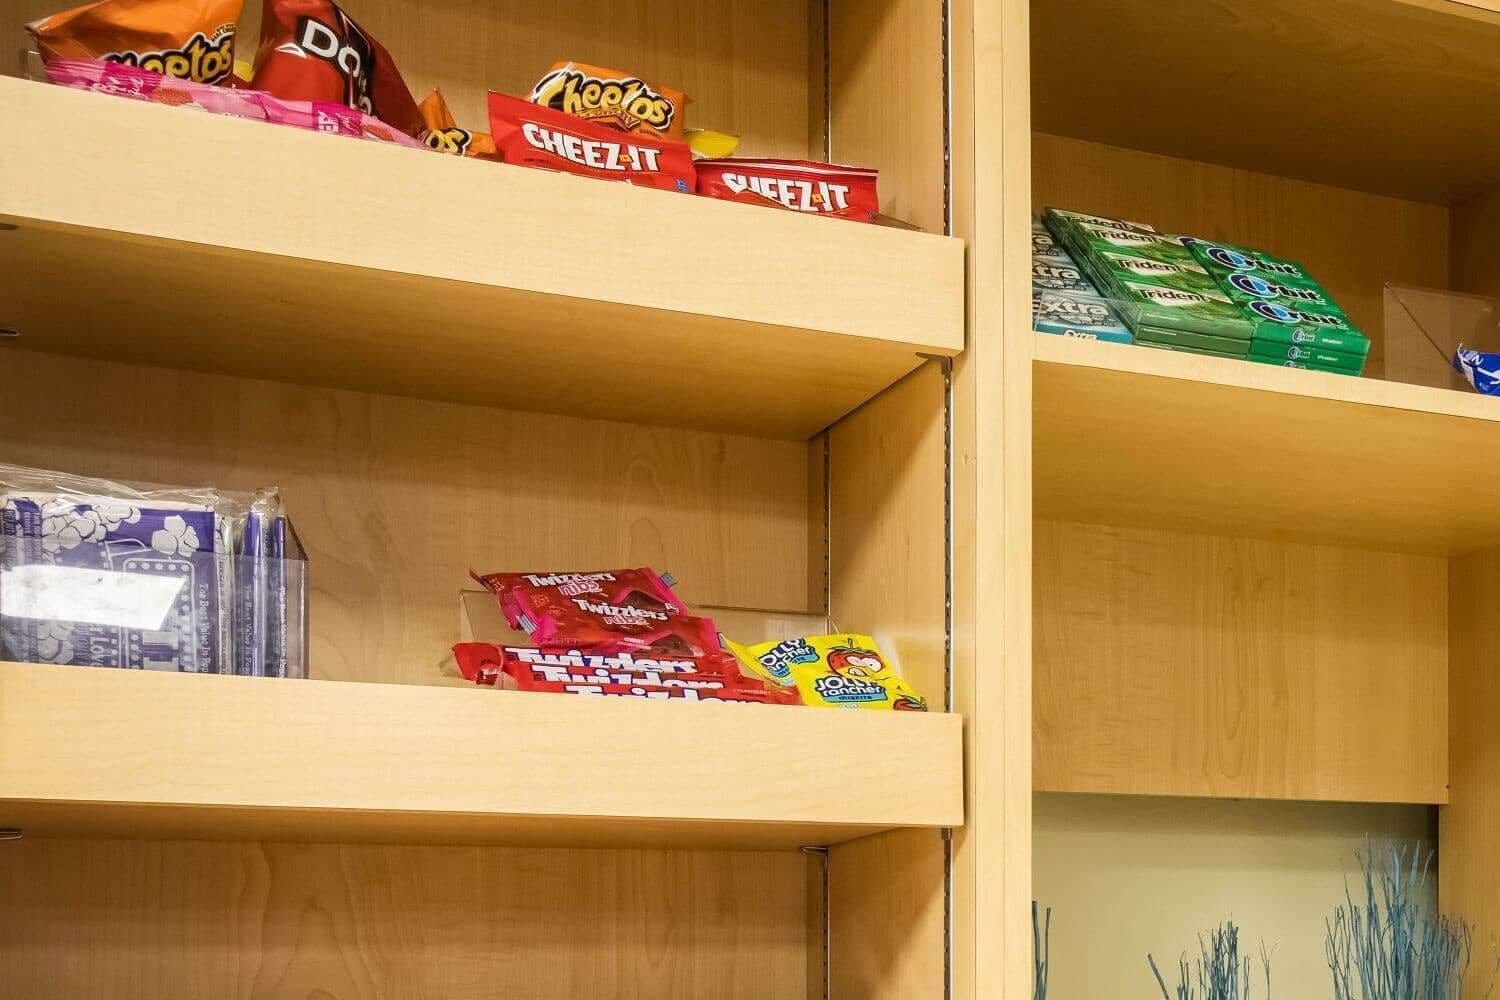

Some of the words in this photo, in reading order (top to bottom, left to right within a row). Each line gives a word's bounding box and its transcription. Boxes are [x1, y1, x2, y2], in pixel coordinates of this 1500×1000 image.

[534, 66, 673, 129] Cheetos
[1092, 229, 1158, 243] Trident
[1116, 259, 1183, 272] Trident
[1139, 289, 1204, 302] Trident
[522, 573, 617, 588] Twizzlers
[572, 598, 668, 620] Twizzlers
[200, 657, 210, 672] Pop
[823, 686, 882, 697] rancher
